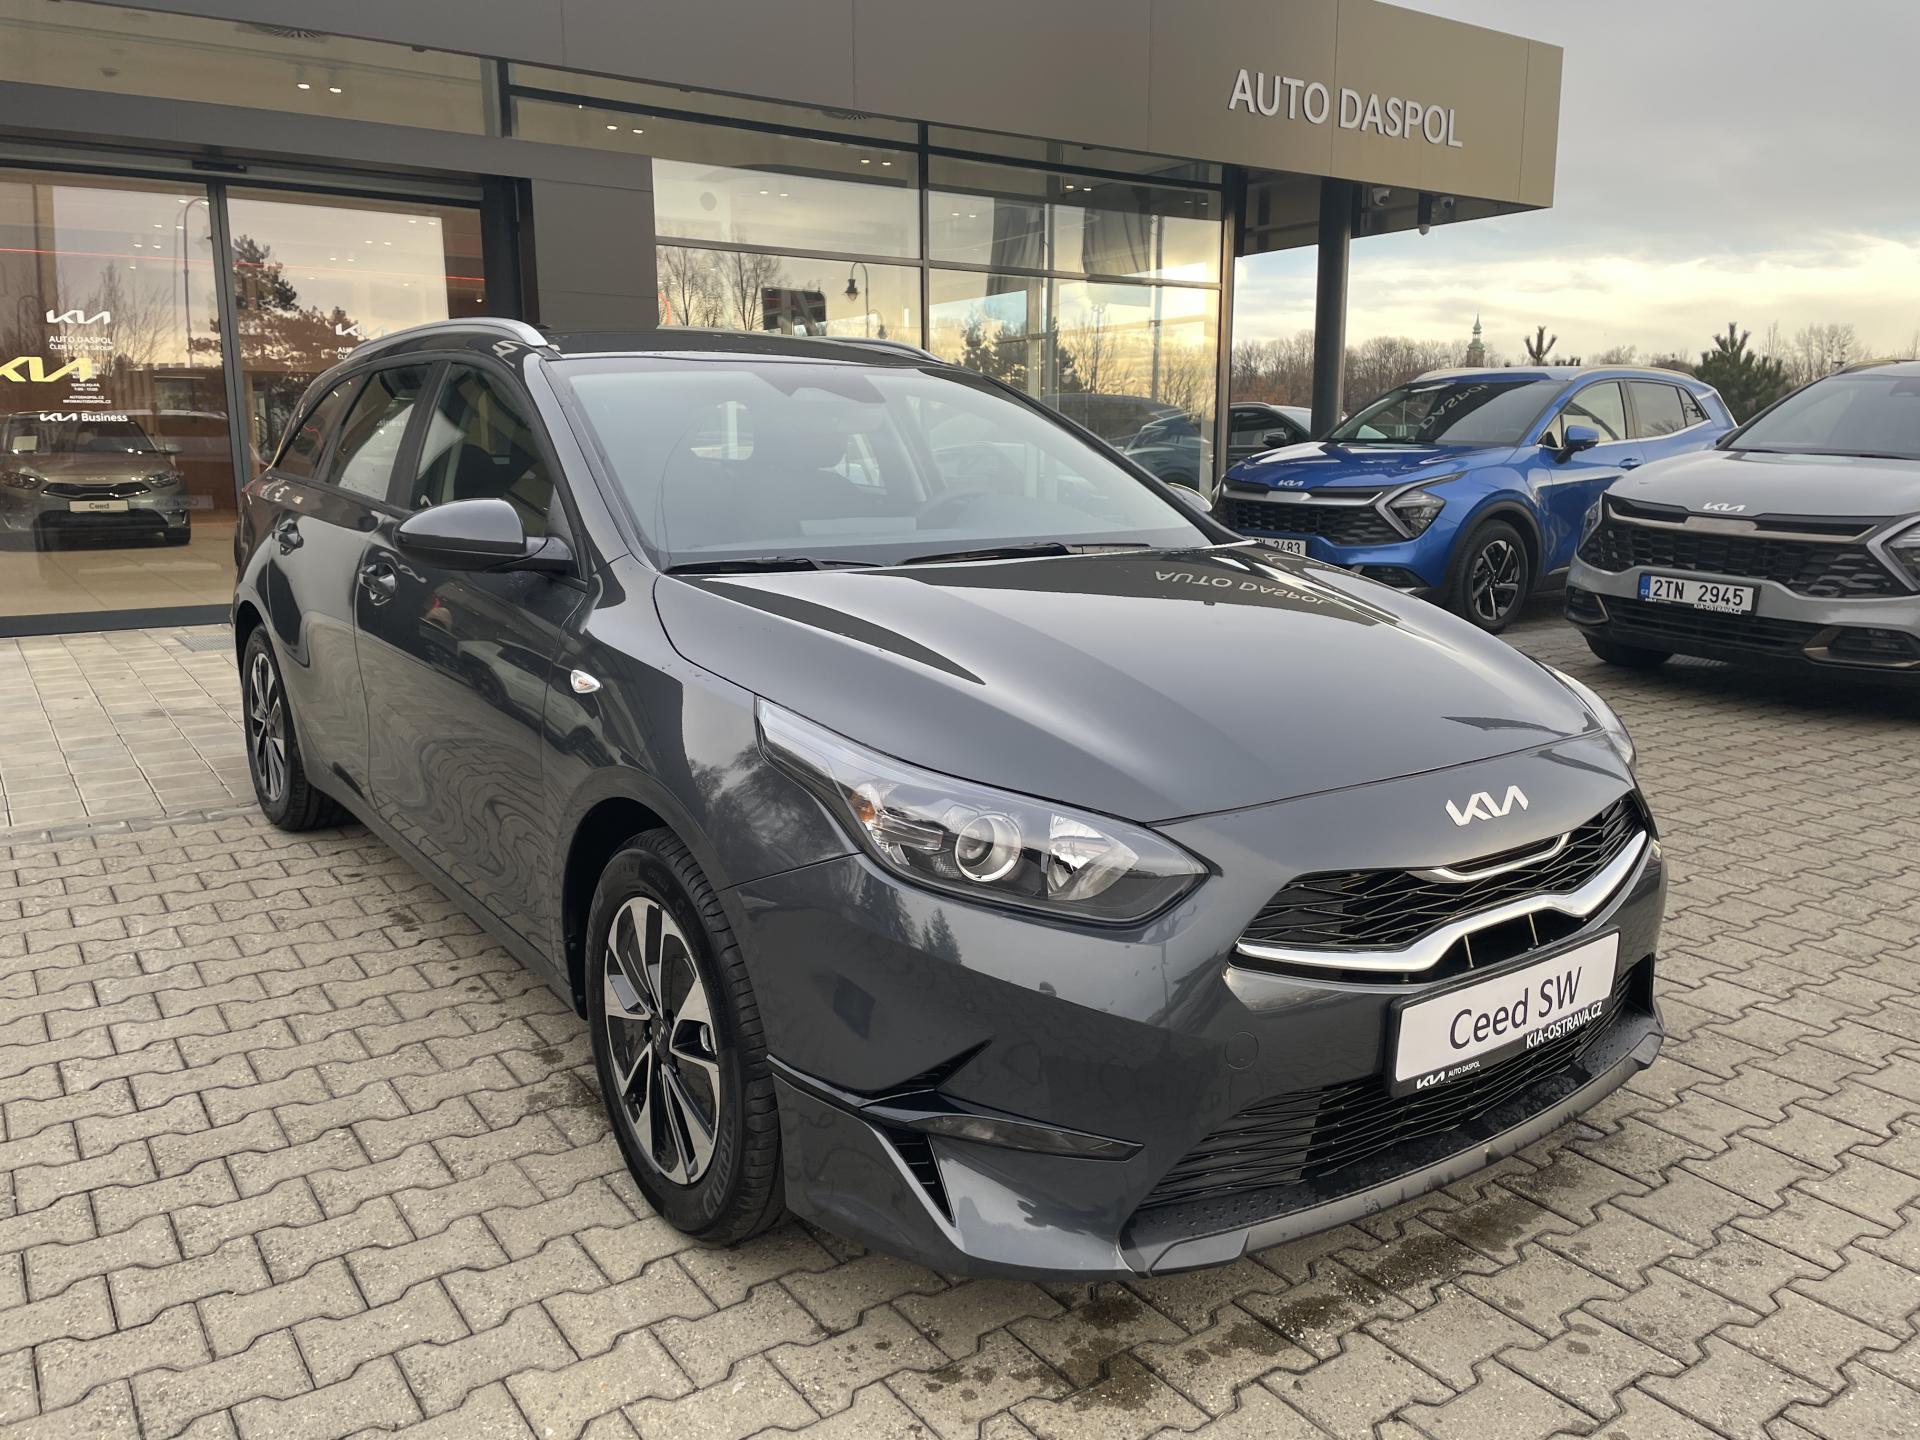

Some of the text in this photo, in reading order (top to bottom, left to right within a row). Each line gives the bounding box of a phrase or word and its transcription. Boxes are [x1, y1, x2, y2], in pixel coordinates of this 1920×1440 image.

[1227, 68, 1464, 148] AUTO DASPOL
[46, 309, 111, 325] KIA
[49, 335, 113, 344] AUTO DASPOL
[39, 412, 128, 422] KIA Business
[1278, 479, 1304, 487] KIA
[1703, 501, 1746, 512] KIA
[1652, 578, 1745, 607] 2TN 2945
[1445, 784, 1529, 827] KIA
[1449, 965, 1582, 1050] Ceed SW
[1526, 1001, 1603, 1049] KIA-OSTRAVA.CZ
[1416, 1060, 1481, 1090] KIA AUTO DASPOL
